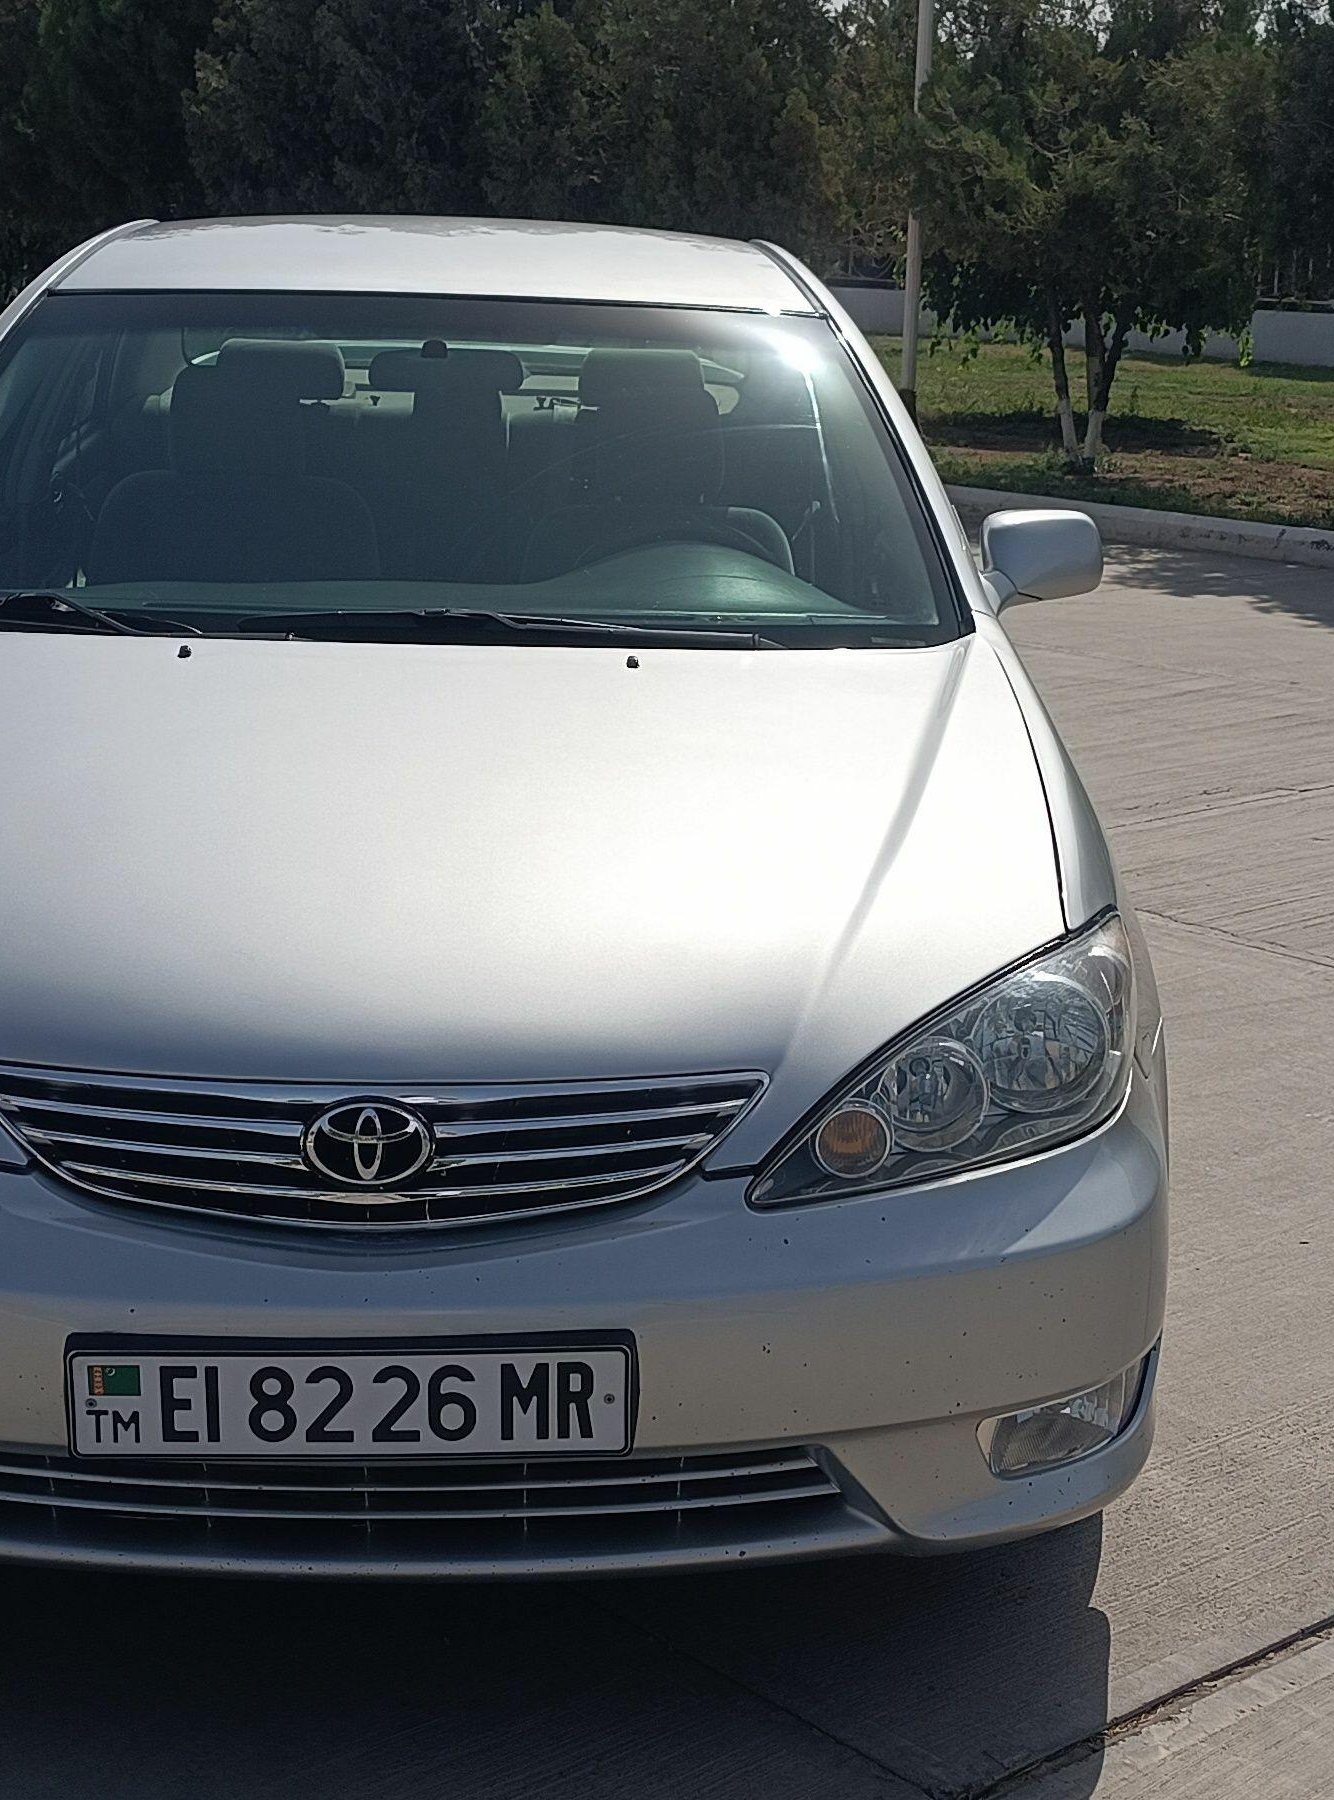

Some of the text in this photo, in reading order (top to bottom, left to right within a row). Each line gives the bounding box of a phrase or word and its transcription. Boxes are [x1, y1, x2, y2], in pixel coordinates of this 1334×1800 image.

[85, 1409, 141, 1444] TM
[159, 1365, 221, 1443] EI
[499, 1361, 595, 1441] MR
